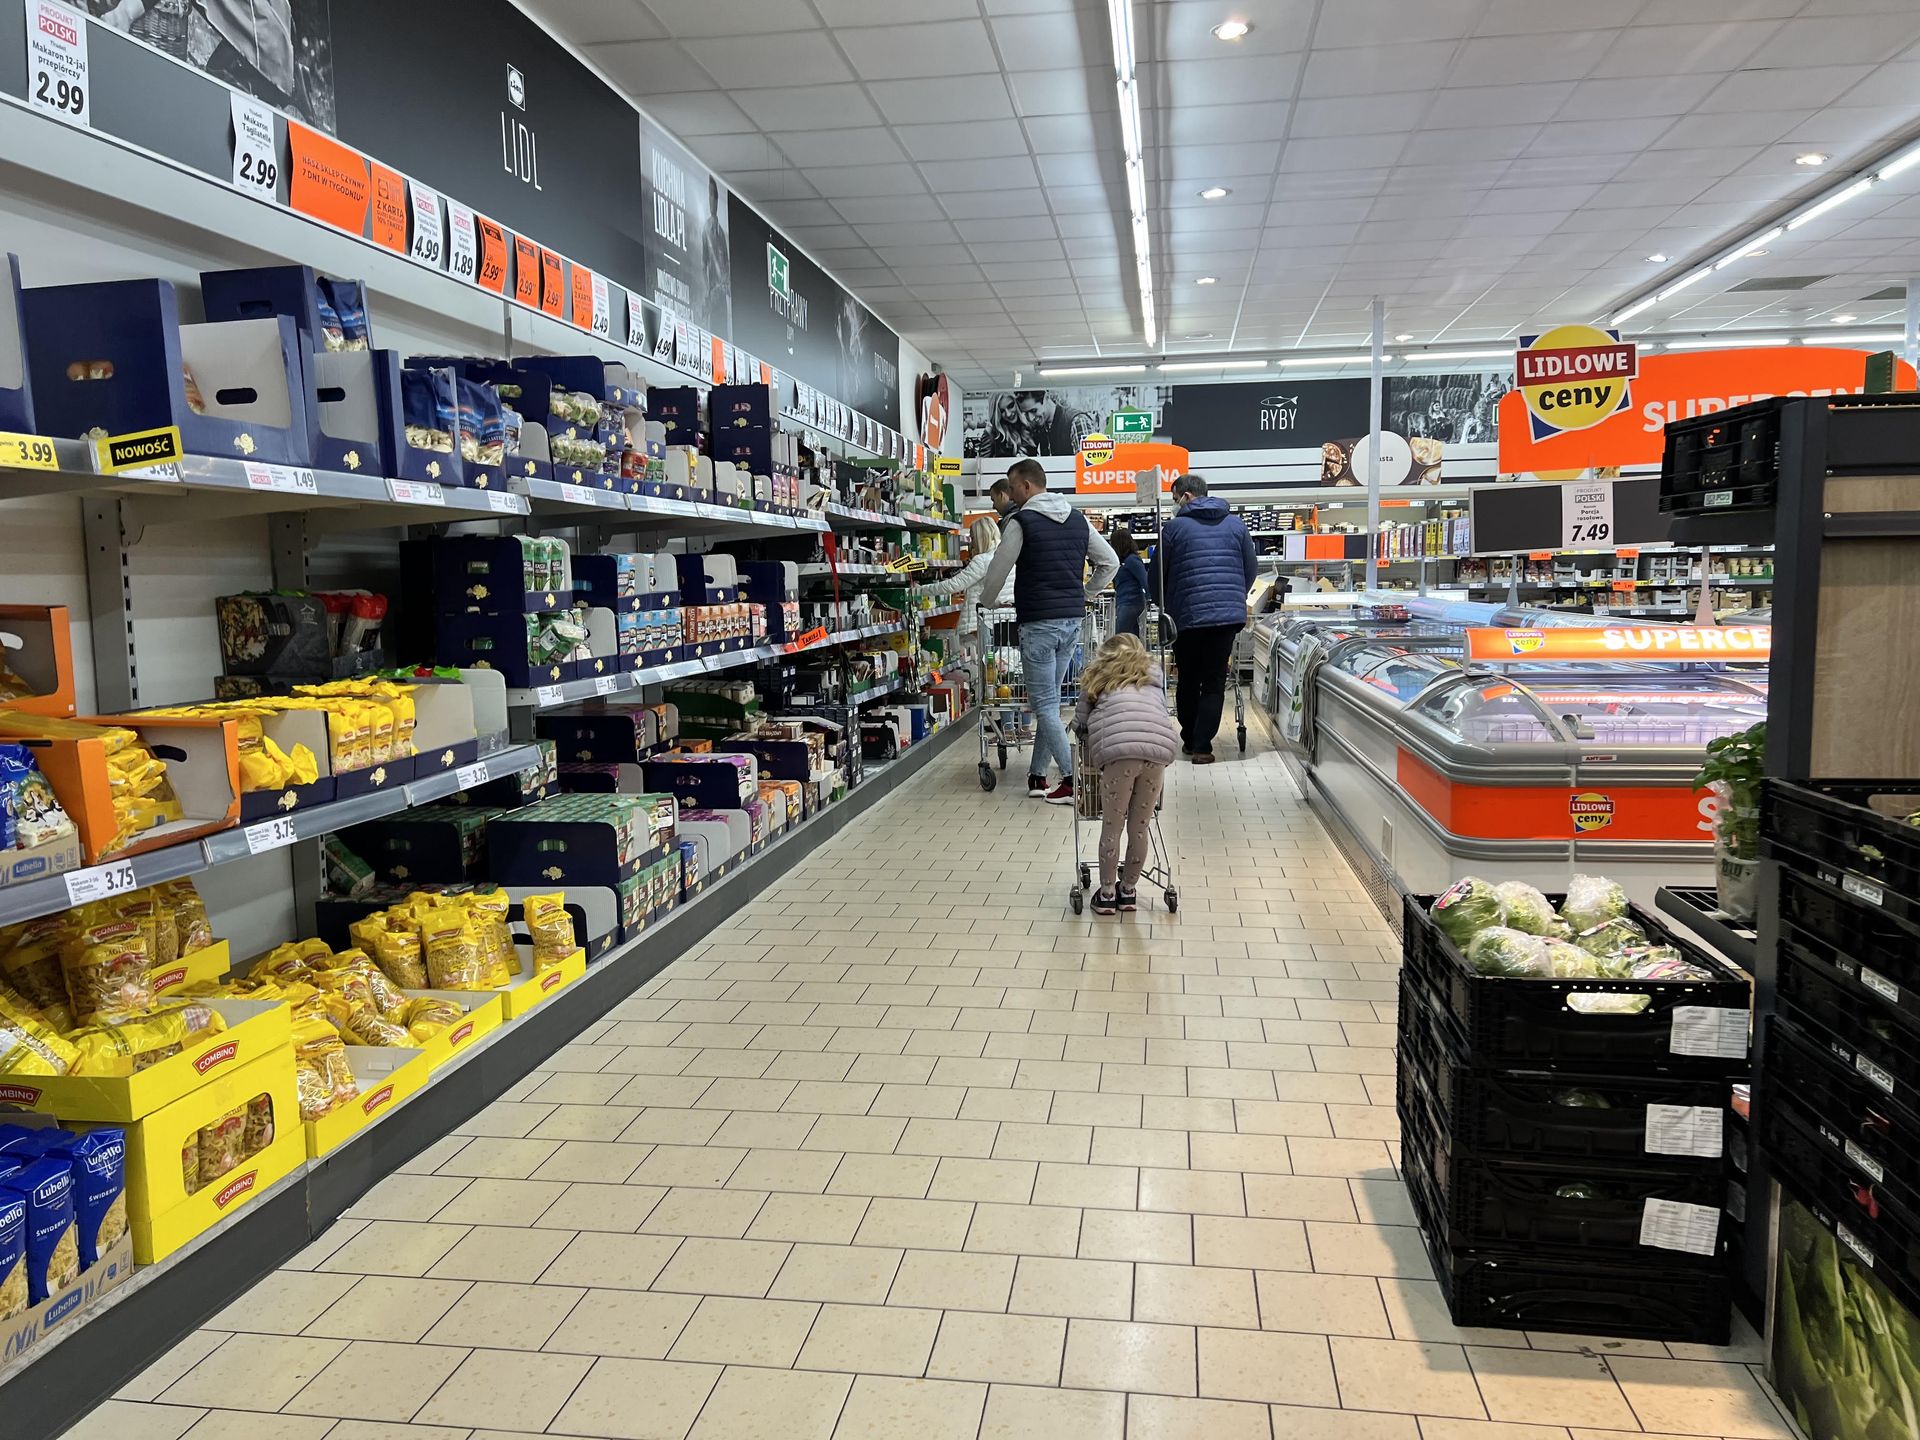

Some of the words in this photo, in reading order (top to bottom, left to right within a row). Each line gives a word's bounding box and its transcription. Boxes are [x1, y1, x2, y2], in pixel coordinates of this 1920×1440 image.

[40, 16, 76, 44] POLSKI
[32, 40, 64, 61] Makaron
[65, 55, 86, 72] 12-jaj
[38, 55, 81, 80] przepiórczy
[36, 71, 84, 115] 2.99
[243, 113, 269, 132] Makaron
[502, 111, 542, 191] LIDL
[239, 152, 277, 190] 2.99
[307, 170, 320, 183] DNI
[321, 176, 328, 187] W
[340, 173, 364, 190] CZYNNY
[415, 235, 440, 262] 4.99
[454, 251, 473, 276] 1.89
[483, 262, 499, 281] 2.99
[520, 279, 532, 296] 2.99
[546, 290, 558, 307] 2.99
[593, 314, 608, 339] 2.49
[629, 329, 644, 347] 3.99
[656, 338, 672, 356] 4.99
[1523, 352, 1629, 379] LIDLOWE
[1539, 384, 1612, 411] ceny
[1260, 408, 1298, 430] RYBY
[18, 440, 53, 463] 3.99
[115, 438, 170, 460] NOWOŚĆ
[1082, 441, 1113, 449] LIDLOWE
[1087, 451, 1108, 459] ceny
[293, 471, 314, 488] 1.49
[1082, 468, 1180, 485] SUPERNA
[1572, 523, 1609, 542] 7.49
[1515, 638, 1539, 647] ceny
[472, 766, 487, 783] 3.75
[1572, 802, 1611, 812] LIDLOWE
[1577, 813, 1605, 824] ceny
[274, 819, 296, 840] 3.75
[15, 860, 43, 873] Lubella
[105, 866, 134, 891] 3.75
[153, 971, 184, 991] COMBINO
[198, 1046, 236, 1070] COMBINO
[365, 1089, 391, 1110] COMBINO
[88, 1186, 118, 1202] ŚWIDERKI
[219, 1177, 253, 1204] COMBINO
[36, 1218, 67, 1237] ŚWIDERKI
[48, 1293, 79, 1322] Lubella
